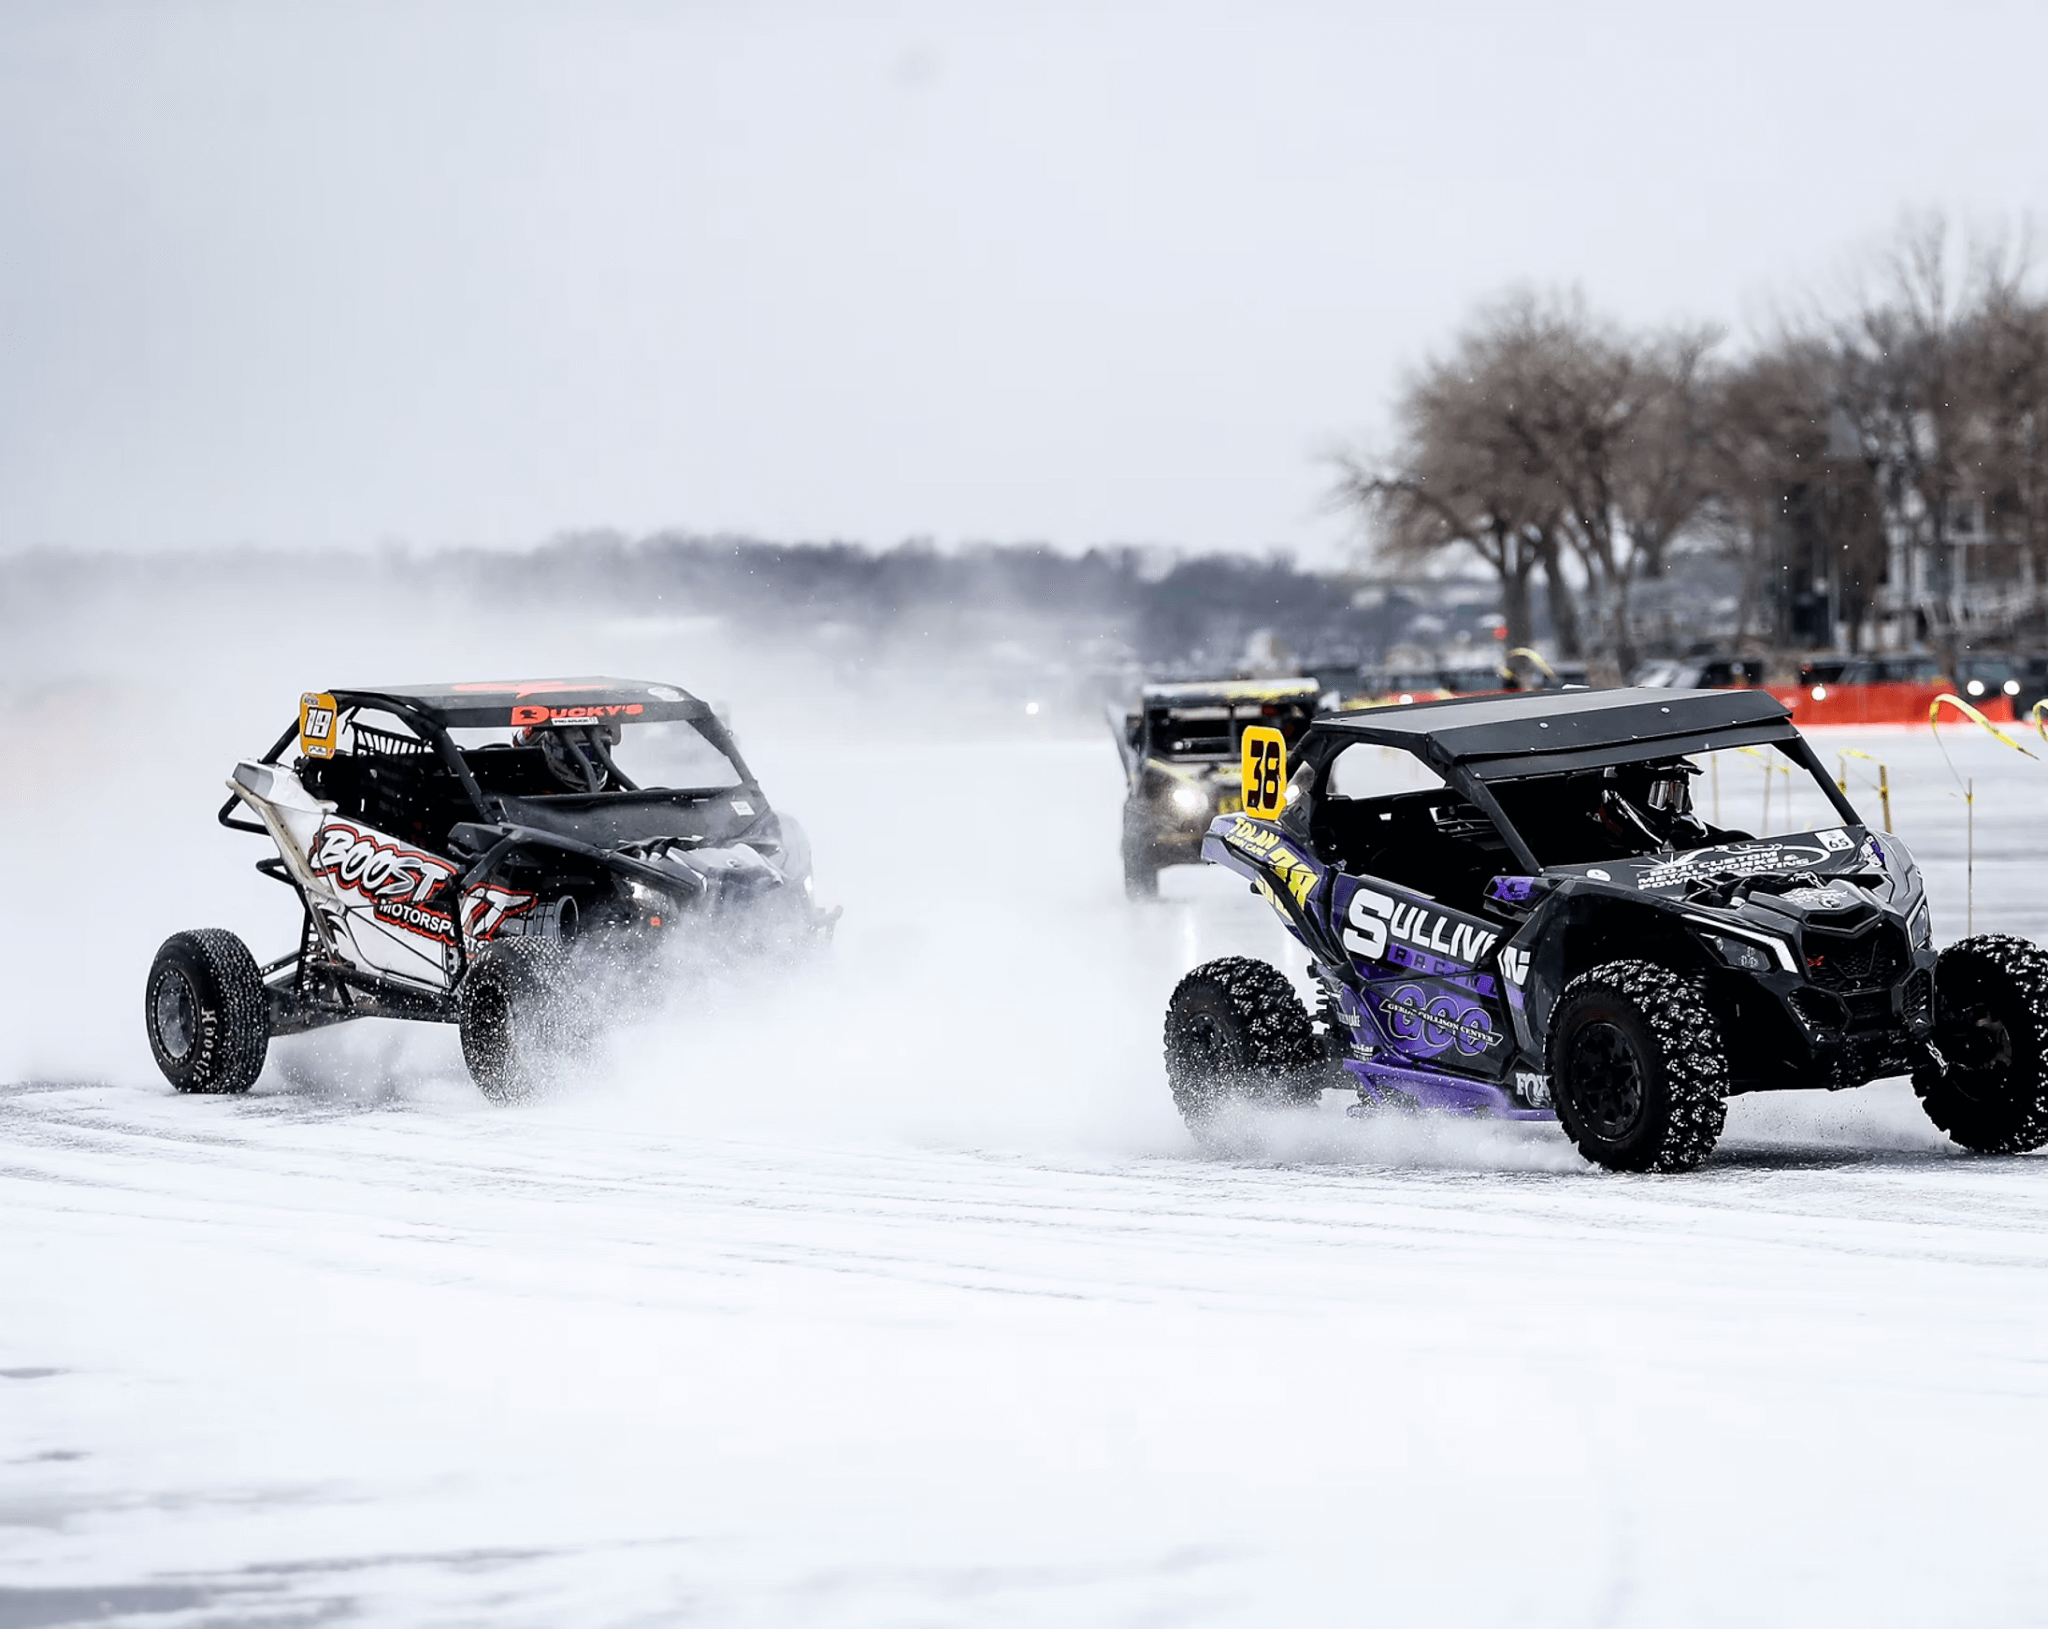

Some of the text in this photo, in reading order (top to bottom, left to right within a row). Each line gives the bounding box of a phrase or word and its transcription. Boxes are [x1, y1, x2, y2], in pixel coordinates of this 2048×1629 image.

[304, 708, 334, 739] 19
[1247, 740, 1280, 810] 38
[1229, 817, 1281, 850] TOLAN
[1829, 838, 1849, 849] 65
[310, 829, 450, 902] BOOST
[1698, 851, 1778, 869] CUSTOM
[1637, 869, 1704, 885] METAL
[1515, 1072, 1552, 1108] FOX
